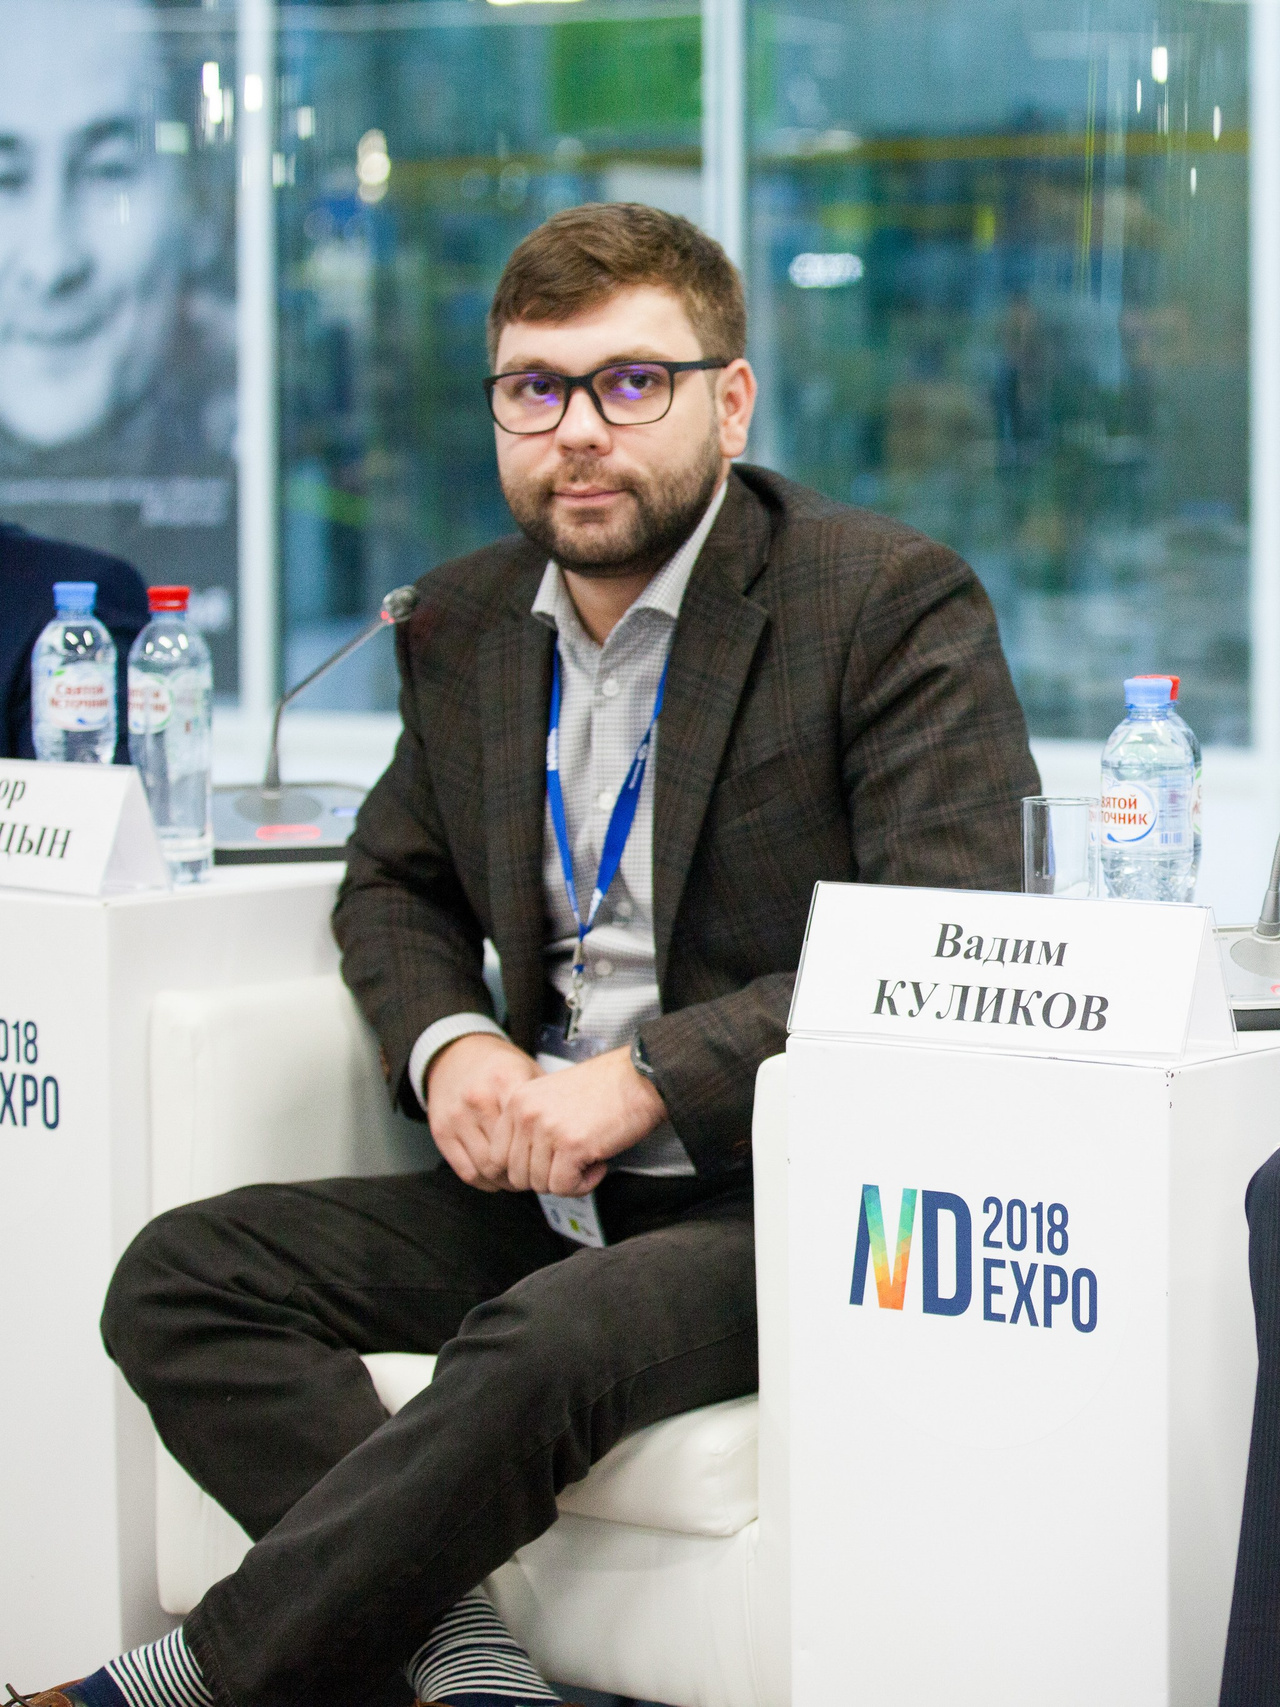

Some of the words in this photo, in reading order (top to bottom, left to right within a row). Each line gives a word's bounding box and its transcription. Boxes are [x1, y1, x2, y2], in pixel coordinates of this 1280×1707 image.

[931, 922, 1069, 968] Вадим
[870, 978, 1109, 1032] КУЛИКОВ
[849, 1183, 973, 1317] ND
[982, 1195, 1070, 1257] 2018
[982, 1256, 1098, 1334] EXPO
